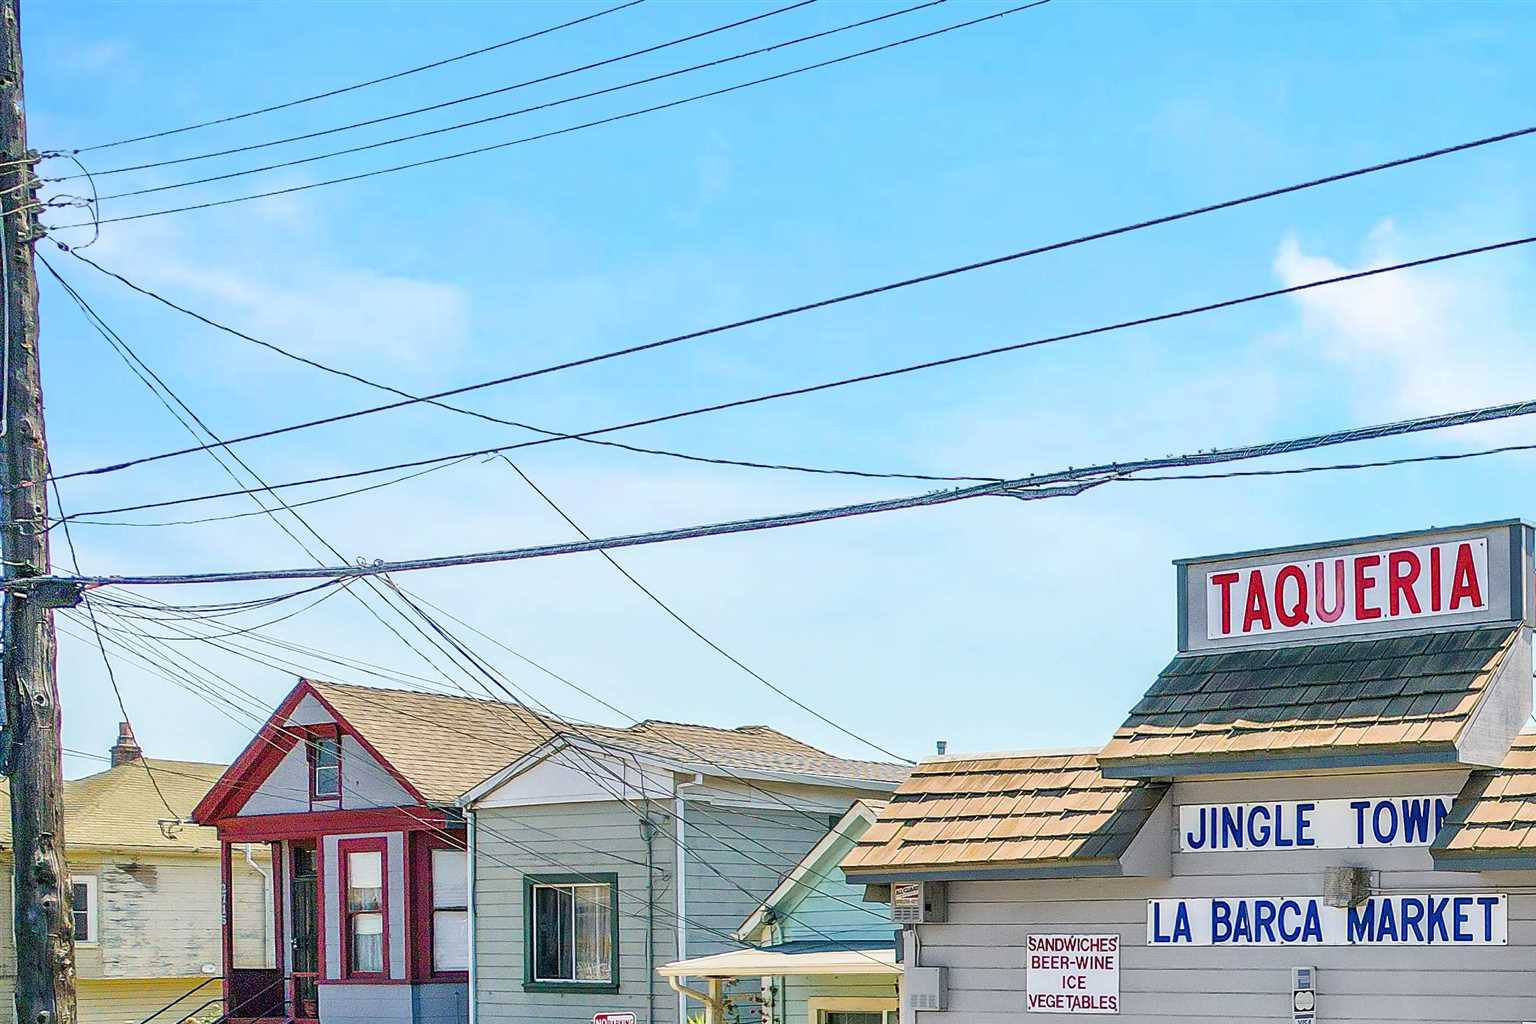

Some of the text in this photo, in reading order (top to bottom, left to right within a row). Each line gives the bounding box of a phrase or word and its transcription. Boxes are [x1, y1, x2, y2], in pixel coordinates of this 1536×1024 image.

[1211, 542, 1483, 635] TAQUERIA
[1187, 803, 1316, 849] JINGLE
[1155, 897, 1499, 944] LA BARCA MARKET
[1028, 937, 1117, 952] SANDWICHES
[1031, 955, 1114, 970] BEER-WINE
[1062, 975, 1087, 989] ICE
[1028, 993, 1117, 1009] VEGETABLES
